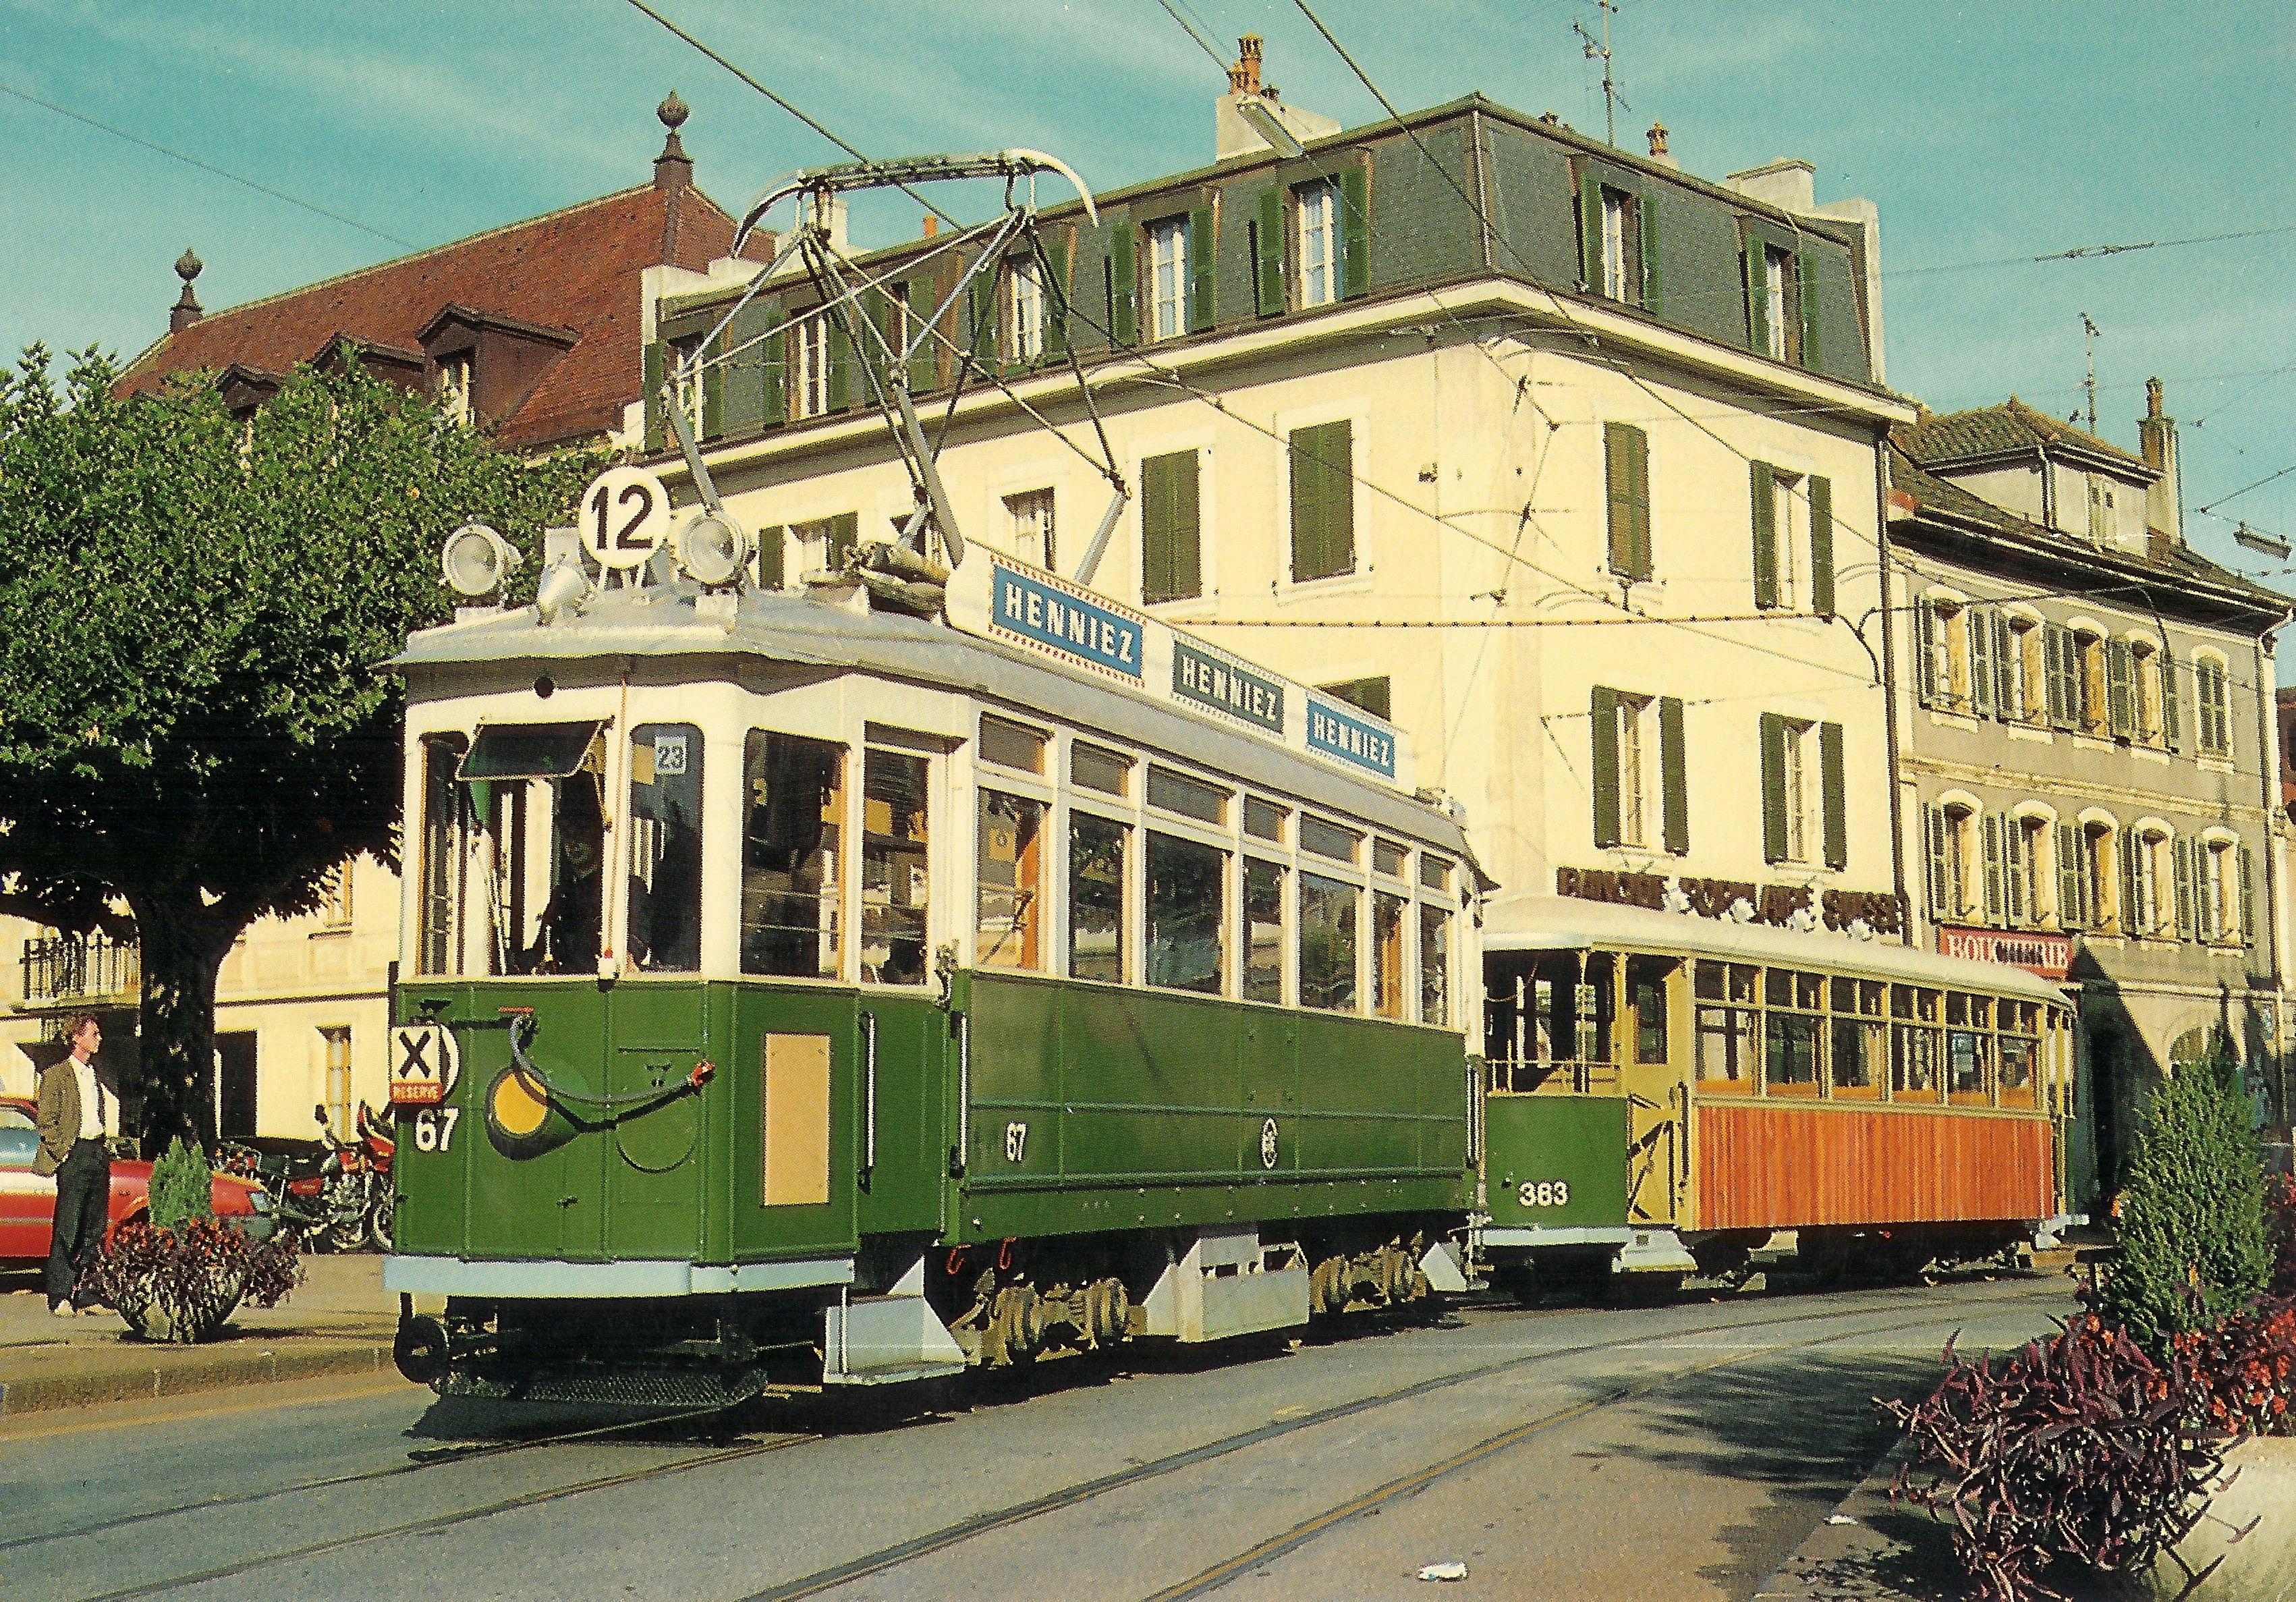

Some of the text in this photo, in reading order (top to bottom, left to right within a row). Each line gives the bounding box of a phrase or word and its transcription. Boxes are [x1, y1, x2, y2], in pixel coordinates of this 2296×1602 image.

[592, 484, 653, 550] 12
[1005, 582, 1134, 664] HENNIEZ
[1182, 654, 1277, 722] HENNIEZ
[658, 746, 683, 769] 23
[1314, 711, 1390, 767] HENNIEZ
[398, 1029, 432, 1080] X
[415, 1107, 459, 1153] 67
[1006, 1121, 1027, 1161] 67
